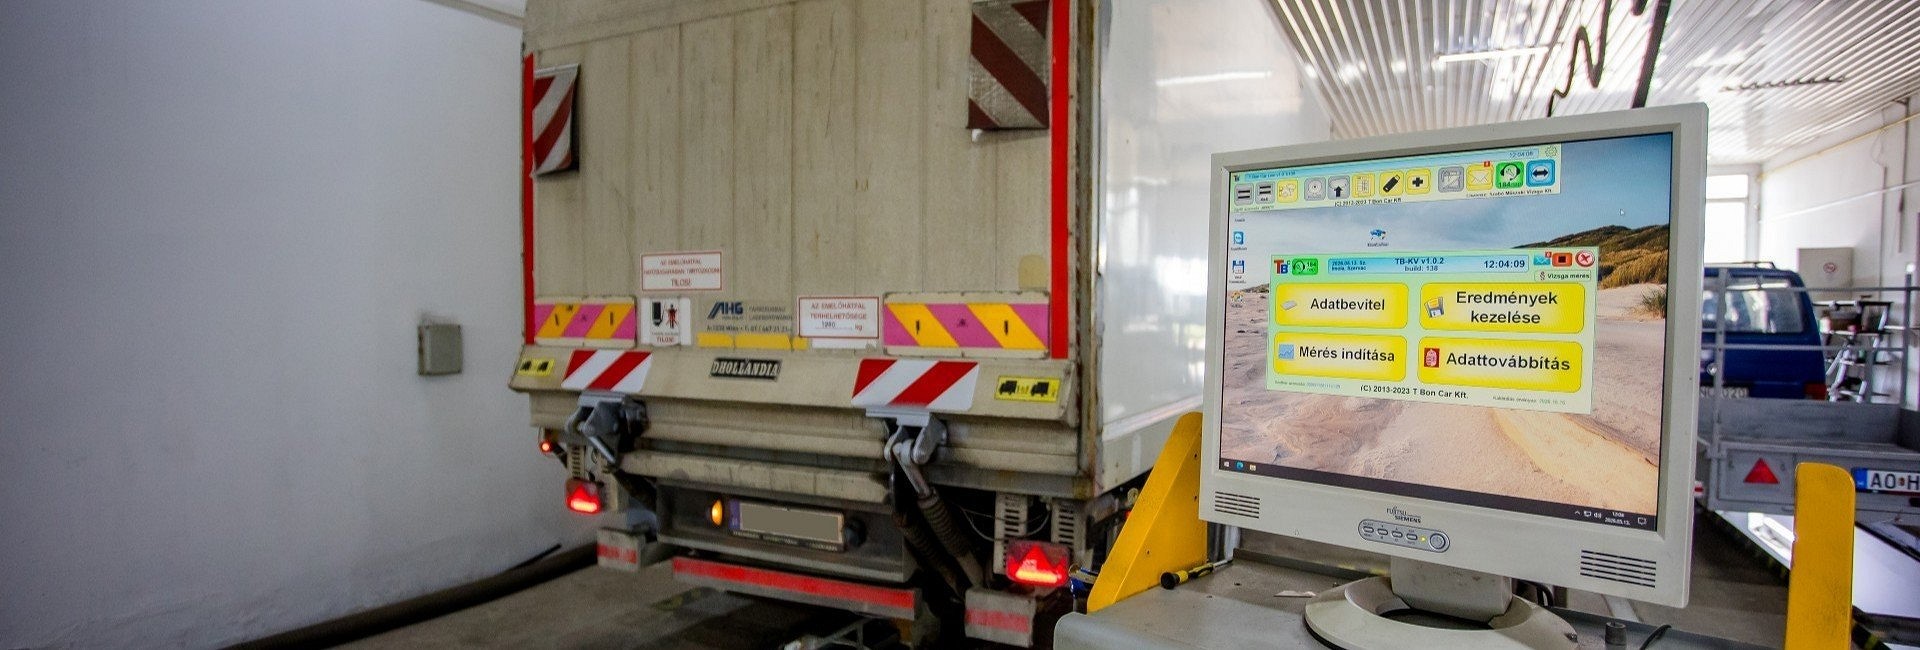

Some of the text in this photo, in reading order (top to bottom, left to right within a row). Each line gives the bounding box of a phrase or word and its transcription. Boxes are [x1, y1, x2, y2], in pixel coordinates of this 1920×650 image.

[1421, 256, 1445, 265] v1.0.2
[1483, 259, 1526, 269] 12:04:09
[1547, 272, 1569, 280] Vizsga
[1310, 297, 1386, 312] Adatbevitel
[1456, 290, 1558, 307] Eredmények
[707, 301, 743, 320] AHG
[1470, 310, 1542, 325] kezelése
[1299, 346, 1395, 362] Mérés indítása
[1446, 352, 1571, 371] Adattovábbítás
[712, 361, 778, 377] DHOLLANDIA
[1361, 385, 1372, 393] (C)
[1373, 386, 1411, 395] 2013-2023
[1419, 388, 1437, 396] Bon
[1438, 389, 1455, 398] Car
[1871, 473, 1896, 489] AO
[1386, 506, 1407, 516] FUJITSU
[1395, 515, 1422, 523] SIEMENS
